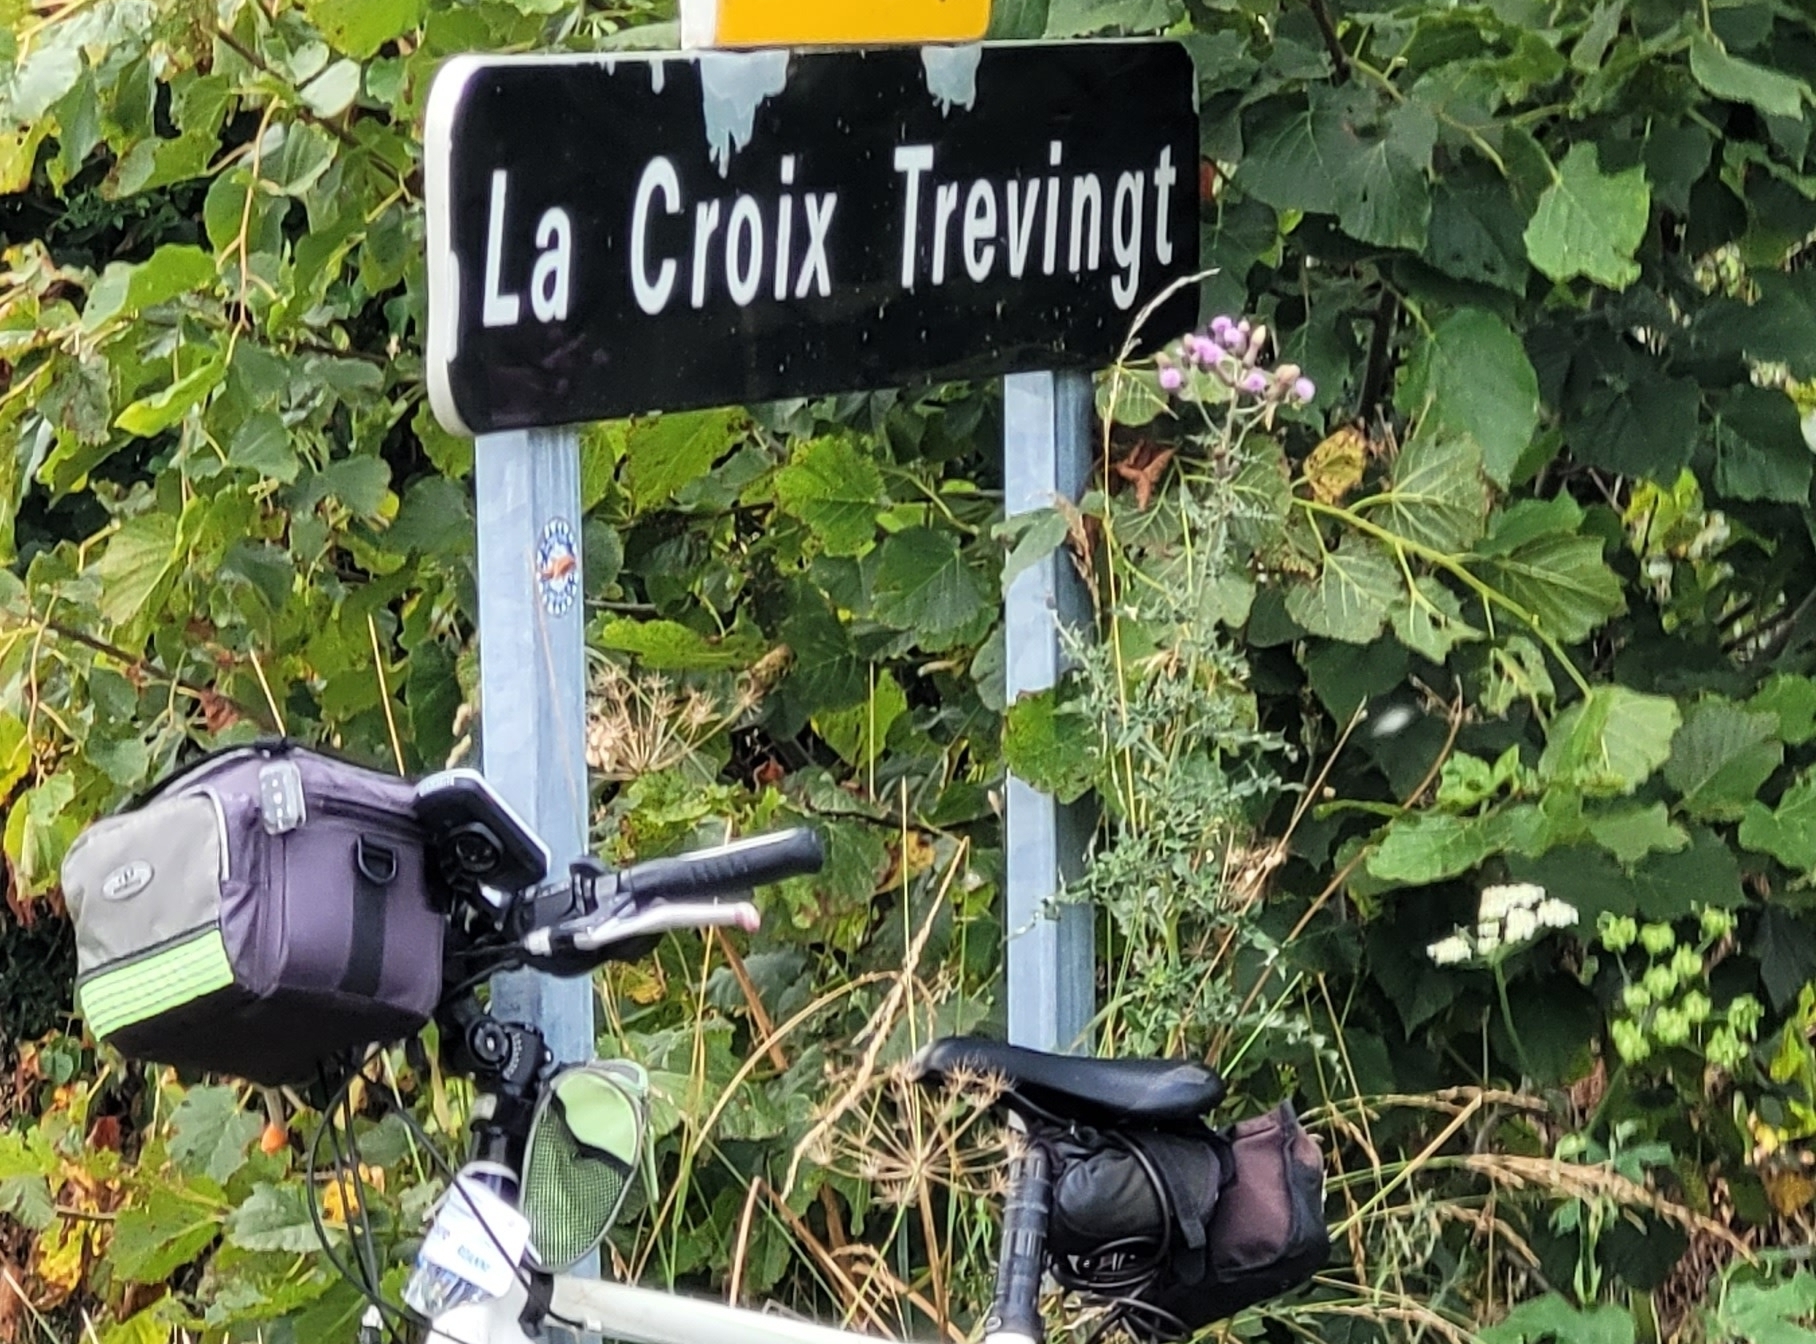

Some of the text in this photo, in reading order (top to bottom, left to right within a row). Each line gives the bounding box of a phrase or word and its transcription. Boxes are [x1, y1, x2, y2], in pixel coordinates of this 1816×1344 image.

[481, 139, 1177, 328] La Croix Trevingt
